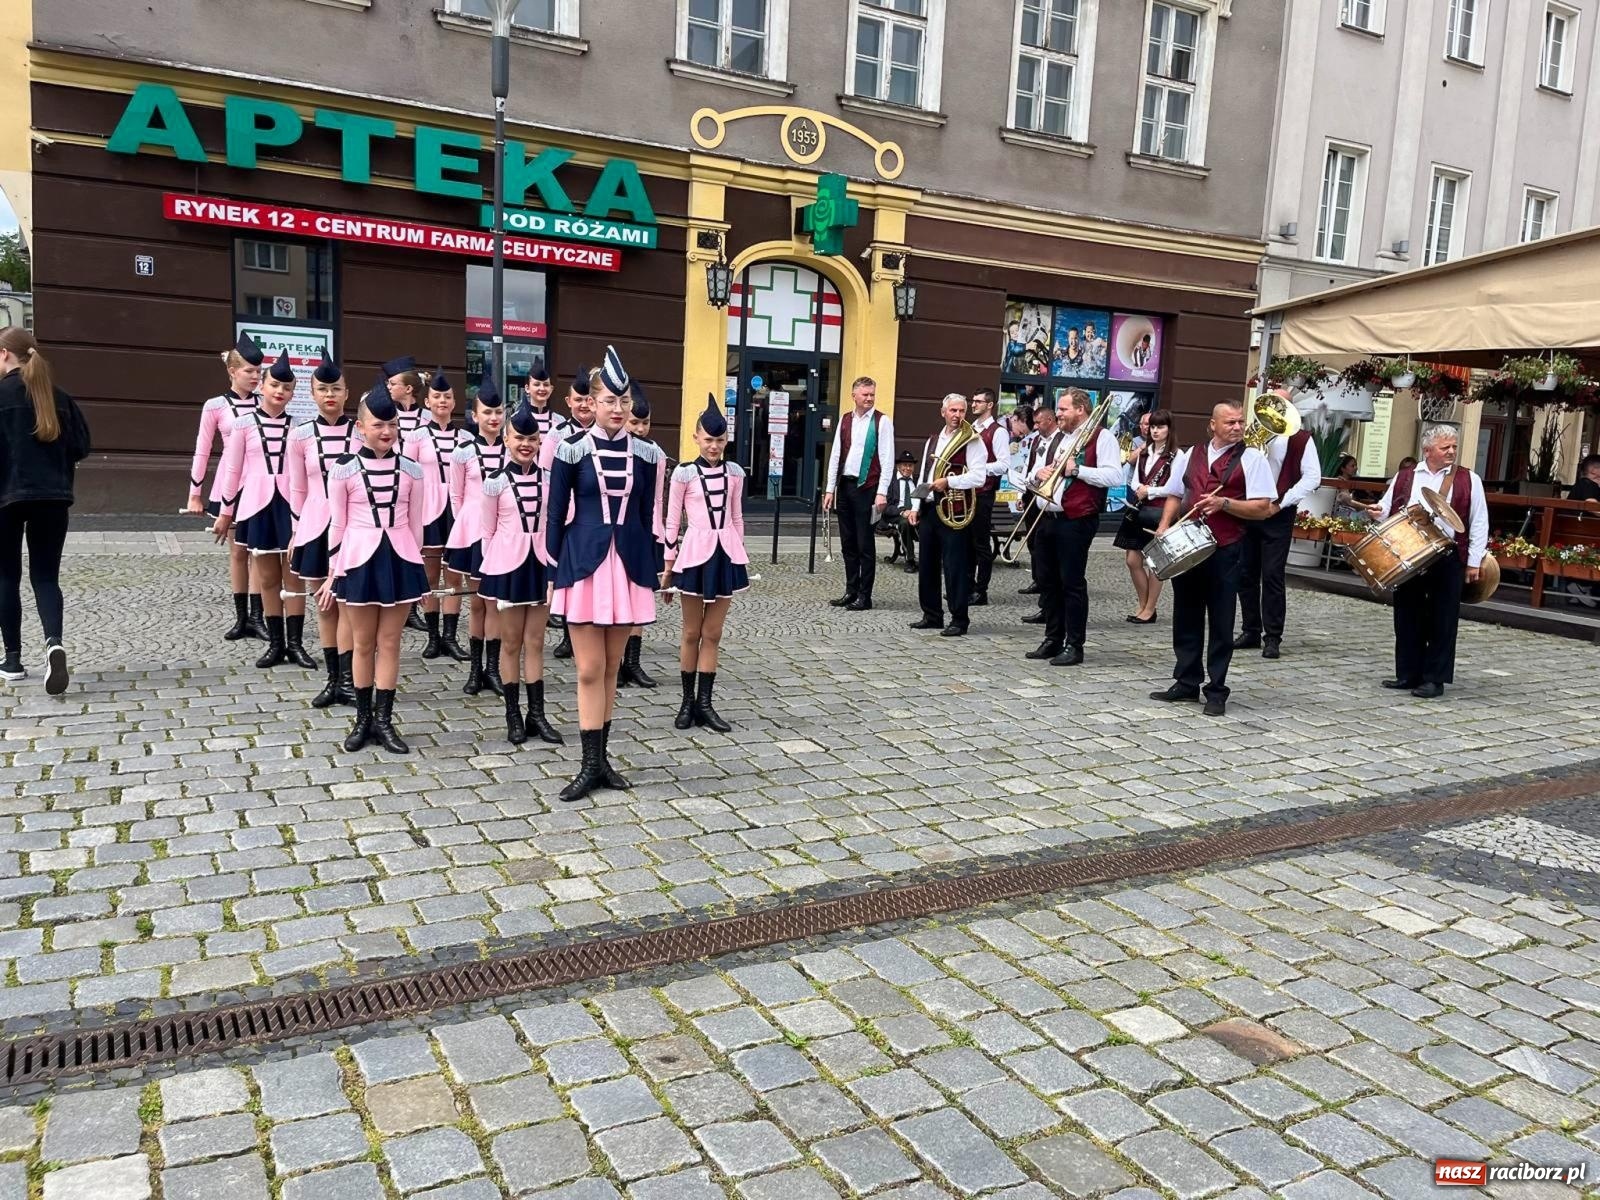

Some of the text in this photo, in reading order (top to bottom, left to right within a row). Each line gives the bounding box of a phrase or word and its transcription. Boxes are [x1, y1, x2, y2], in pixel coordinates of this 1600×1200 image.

[801, 120, 808, 129] A
[791, 128, 817, 145] 1953
[106, 83, 656, 225] APTEKA
[800, 144, 807, 155] D
[174, 199, 260, 225] RYNEK
[267, 211, 295, 229] 12
[315, 217, 425, 245] CENTRUM
[431, 230, 613, 267] FARMACEUTYCZNE
[554, 218, 649, 245] RÓŻAMI
[139, 261, 149, 271] 12
[269, 342, 322, 352] APTEKA
